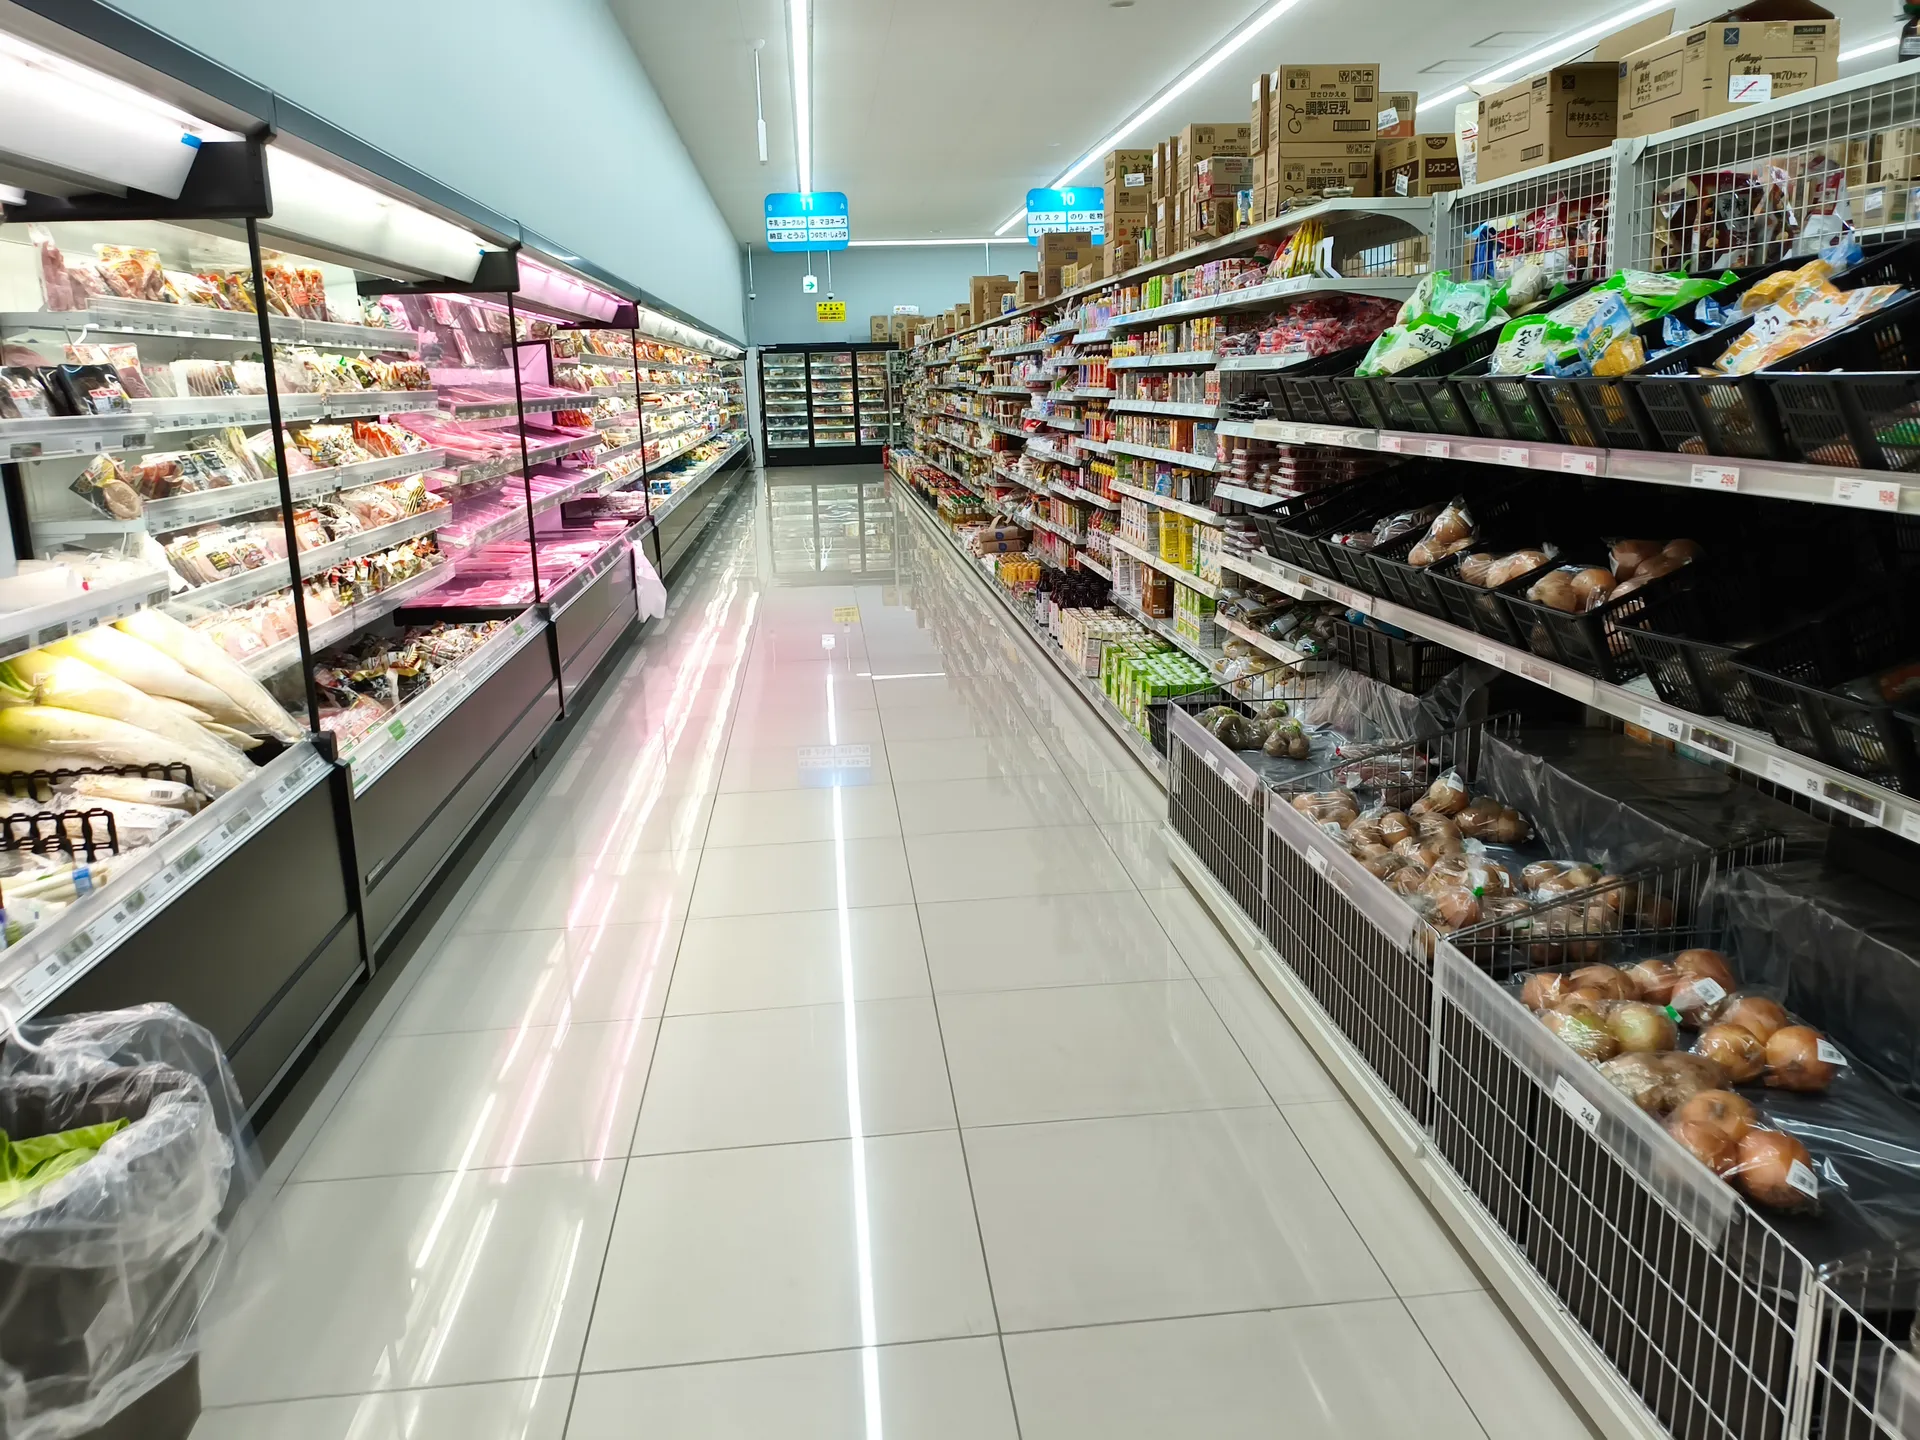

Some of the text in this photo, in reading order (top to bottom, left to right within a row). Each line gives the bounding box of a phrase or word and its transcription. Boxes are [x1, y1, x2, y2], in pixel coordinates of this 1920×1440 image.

[1305, 100, 1351, 115] 調製豆乳
[1428, 163, 1457, 173] シスコーン
[800, 197, 814, 211] 11
[1060, 192, 1076, 206] 10
[1512, 329, 1533, 359] れんこん
[1668, 722, 1678, 734] 128
[1806, 778, 1819, 792] 99
